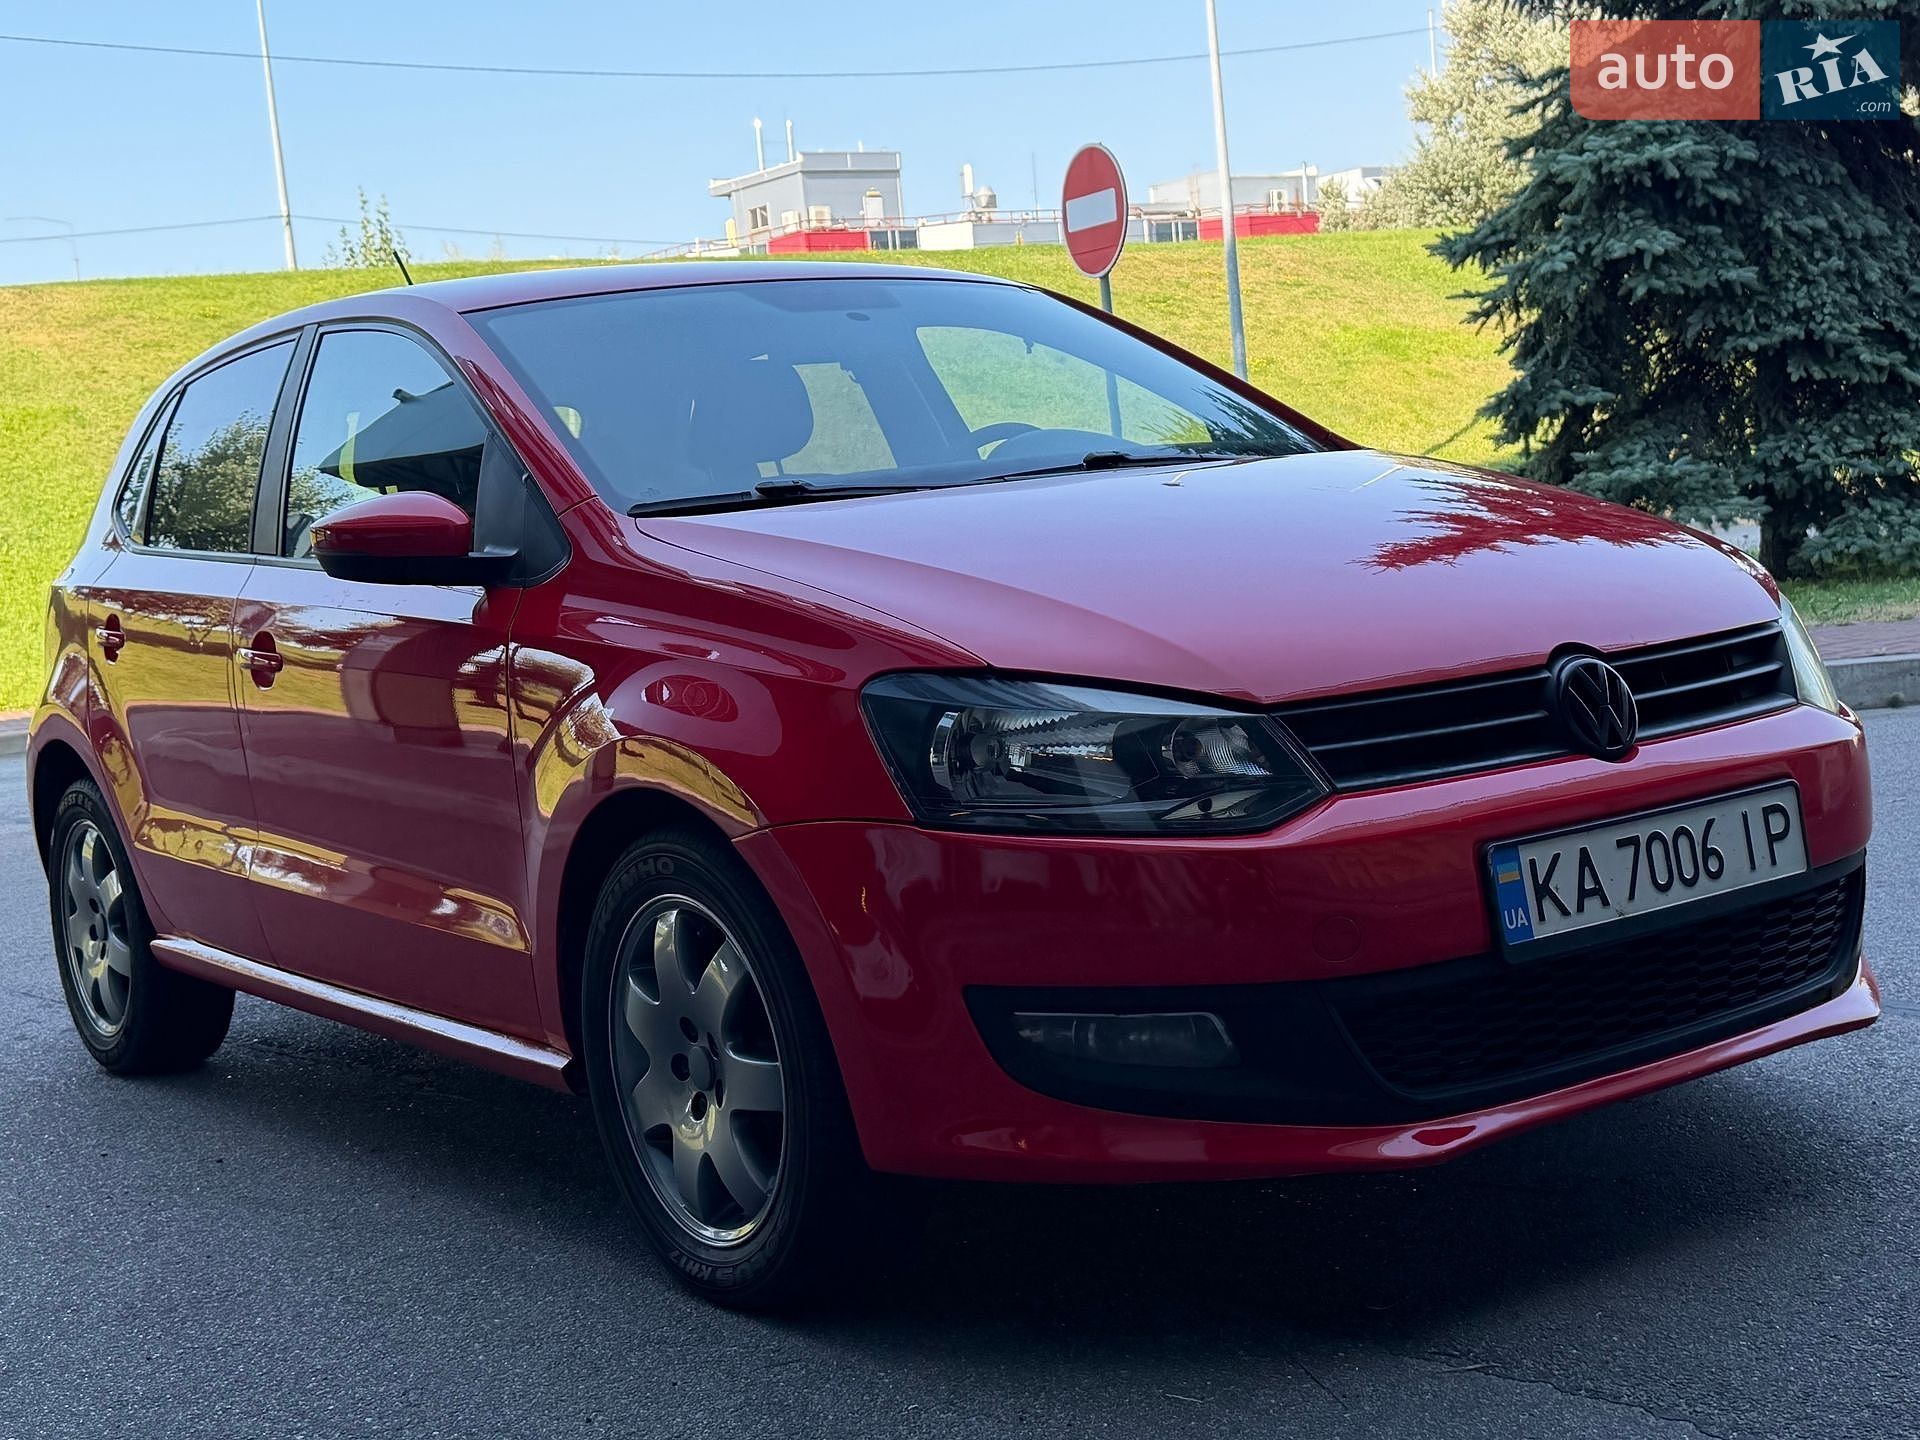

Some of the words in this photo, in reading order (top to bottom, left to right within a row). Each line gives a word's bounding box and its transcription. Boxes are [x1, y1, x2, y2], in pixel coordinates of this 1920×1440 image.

[1528, 846, 1611, 922] KA
[1615, 817, 1725, 902] 7006
[1741, 802, 1791, 871] IP
[1504, 906, 1529, 930] UA
